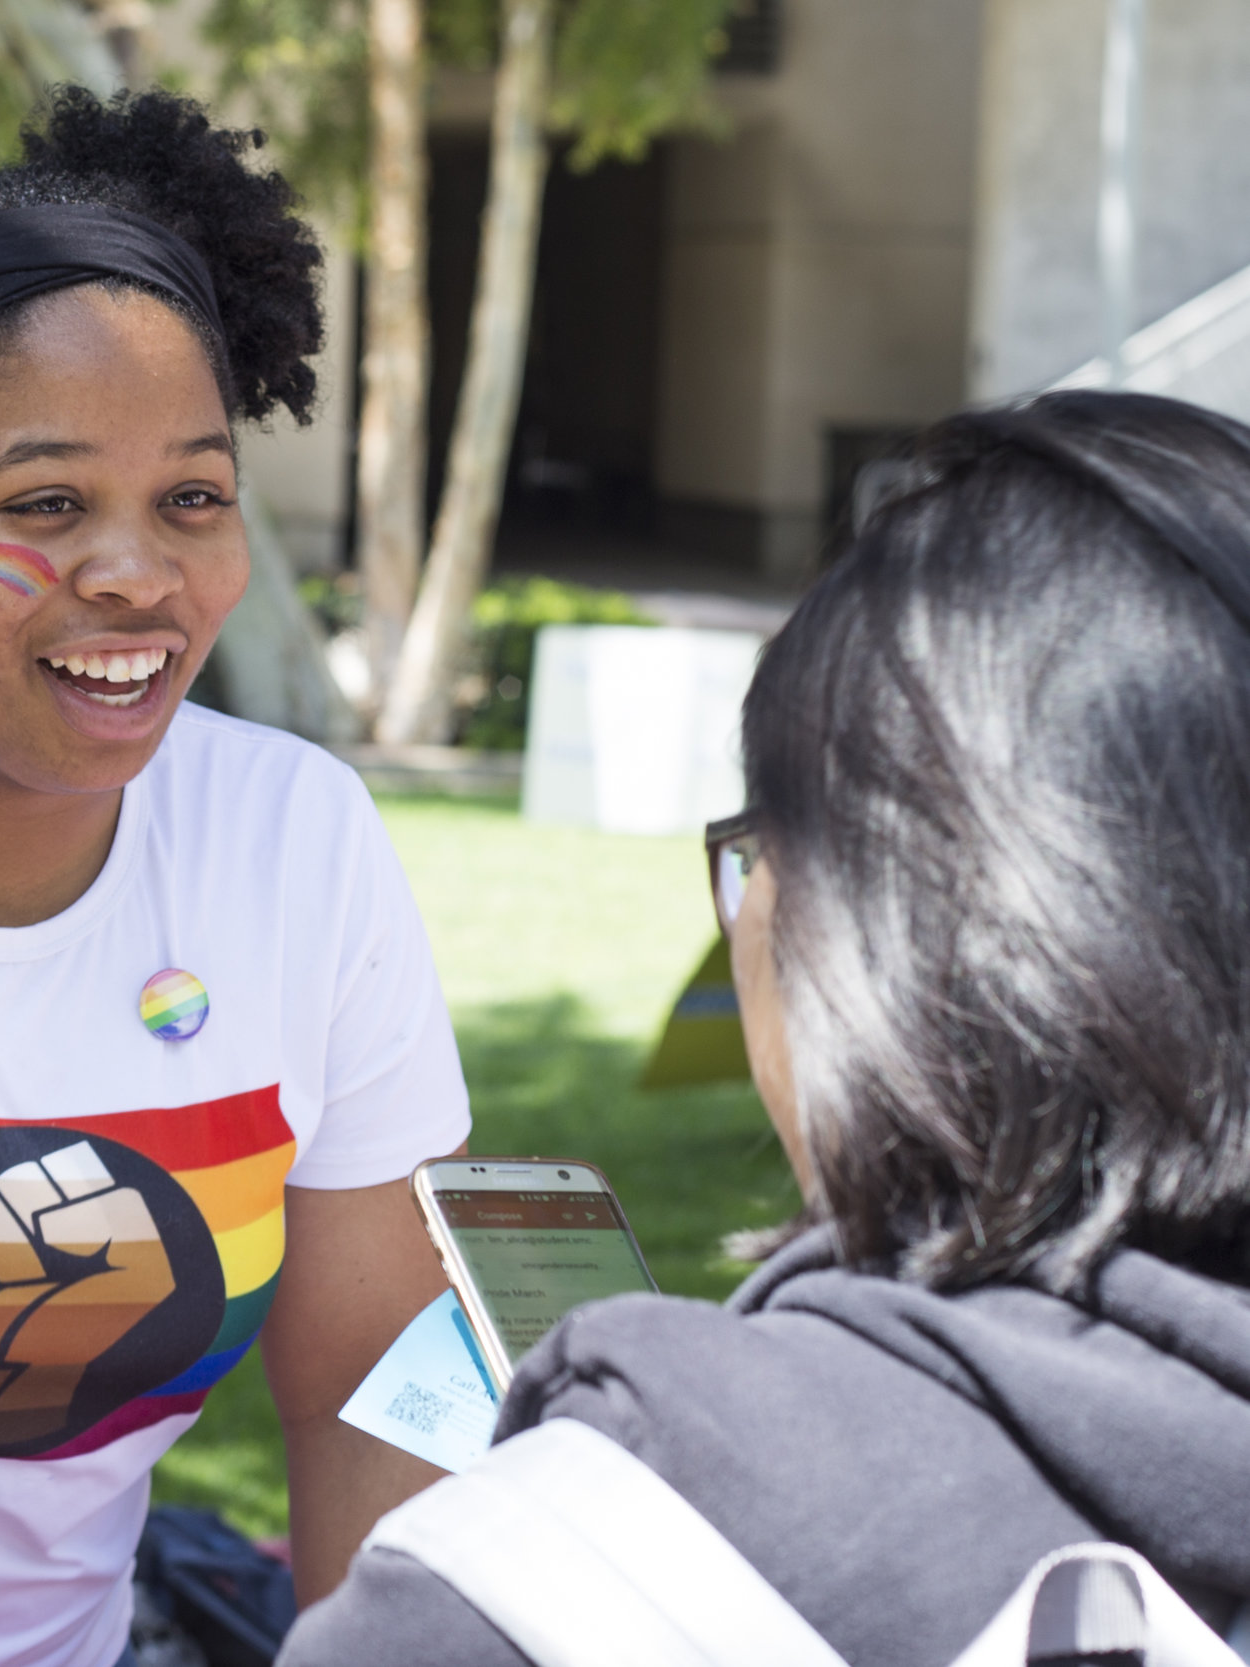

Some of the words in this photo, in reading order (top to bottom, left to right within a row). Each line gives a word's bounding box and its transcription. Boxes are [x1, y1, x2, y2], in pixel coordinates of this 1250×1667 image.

[477, 1211, 523, 1222] Compose
[512, 1288, 546, 1298] March
[450, 1375, 478, 1393] Call
